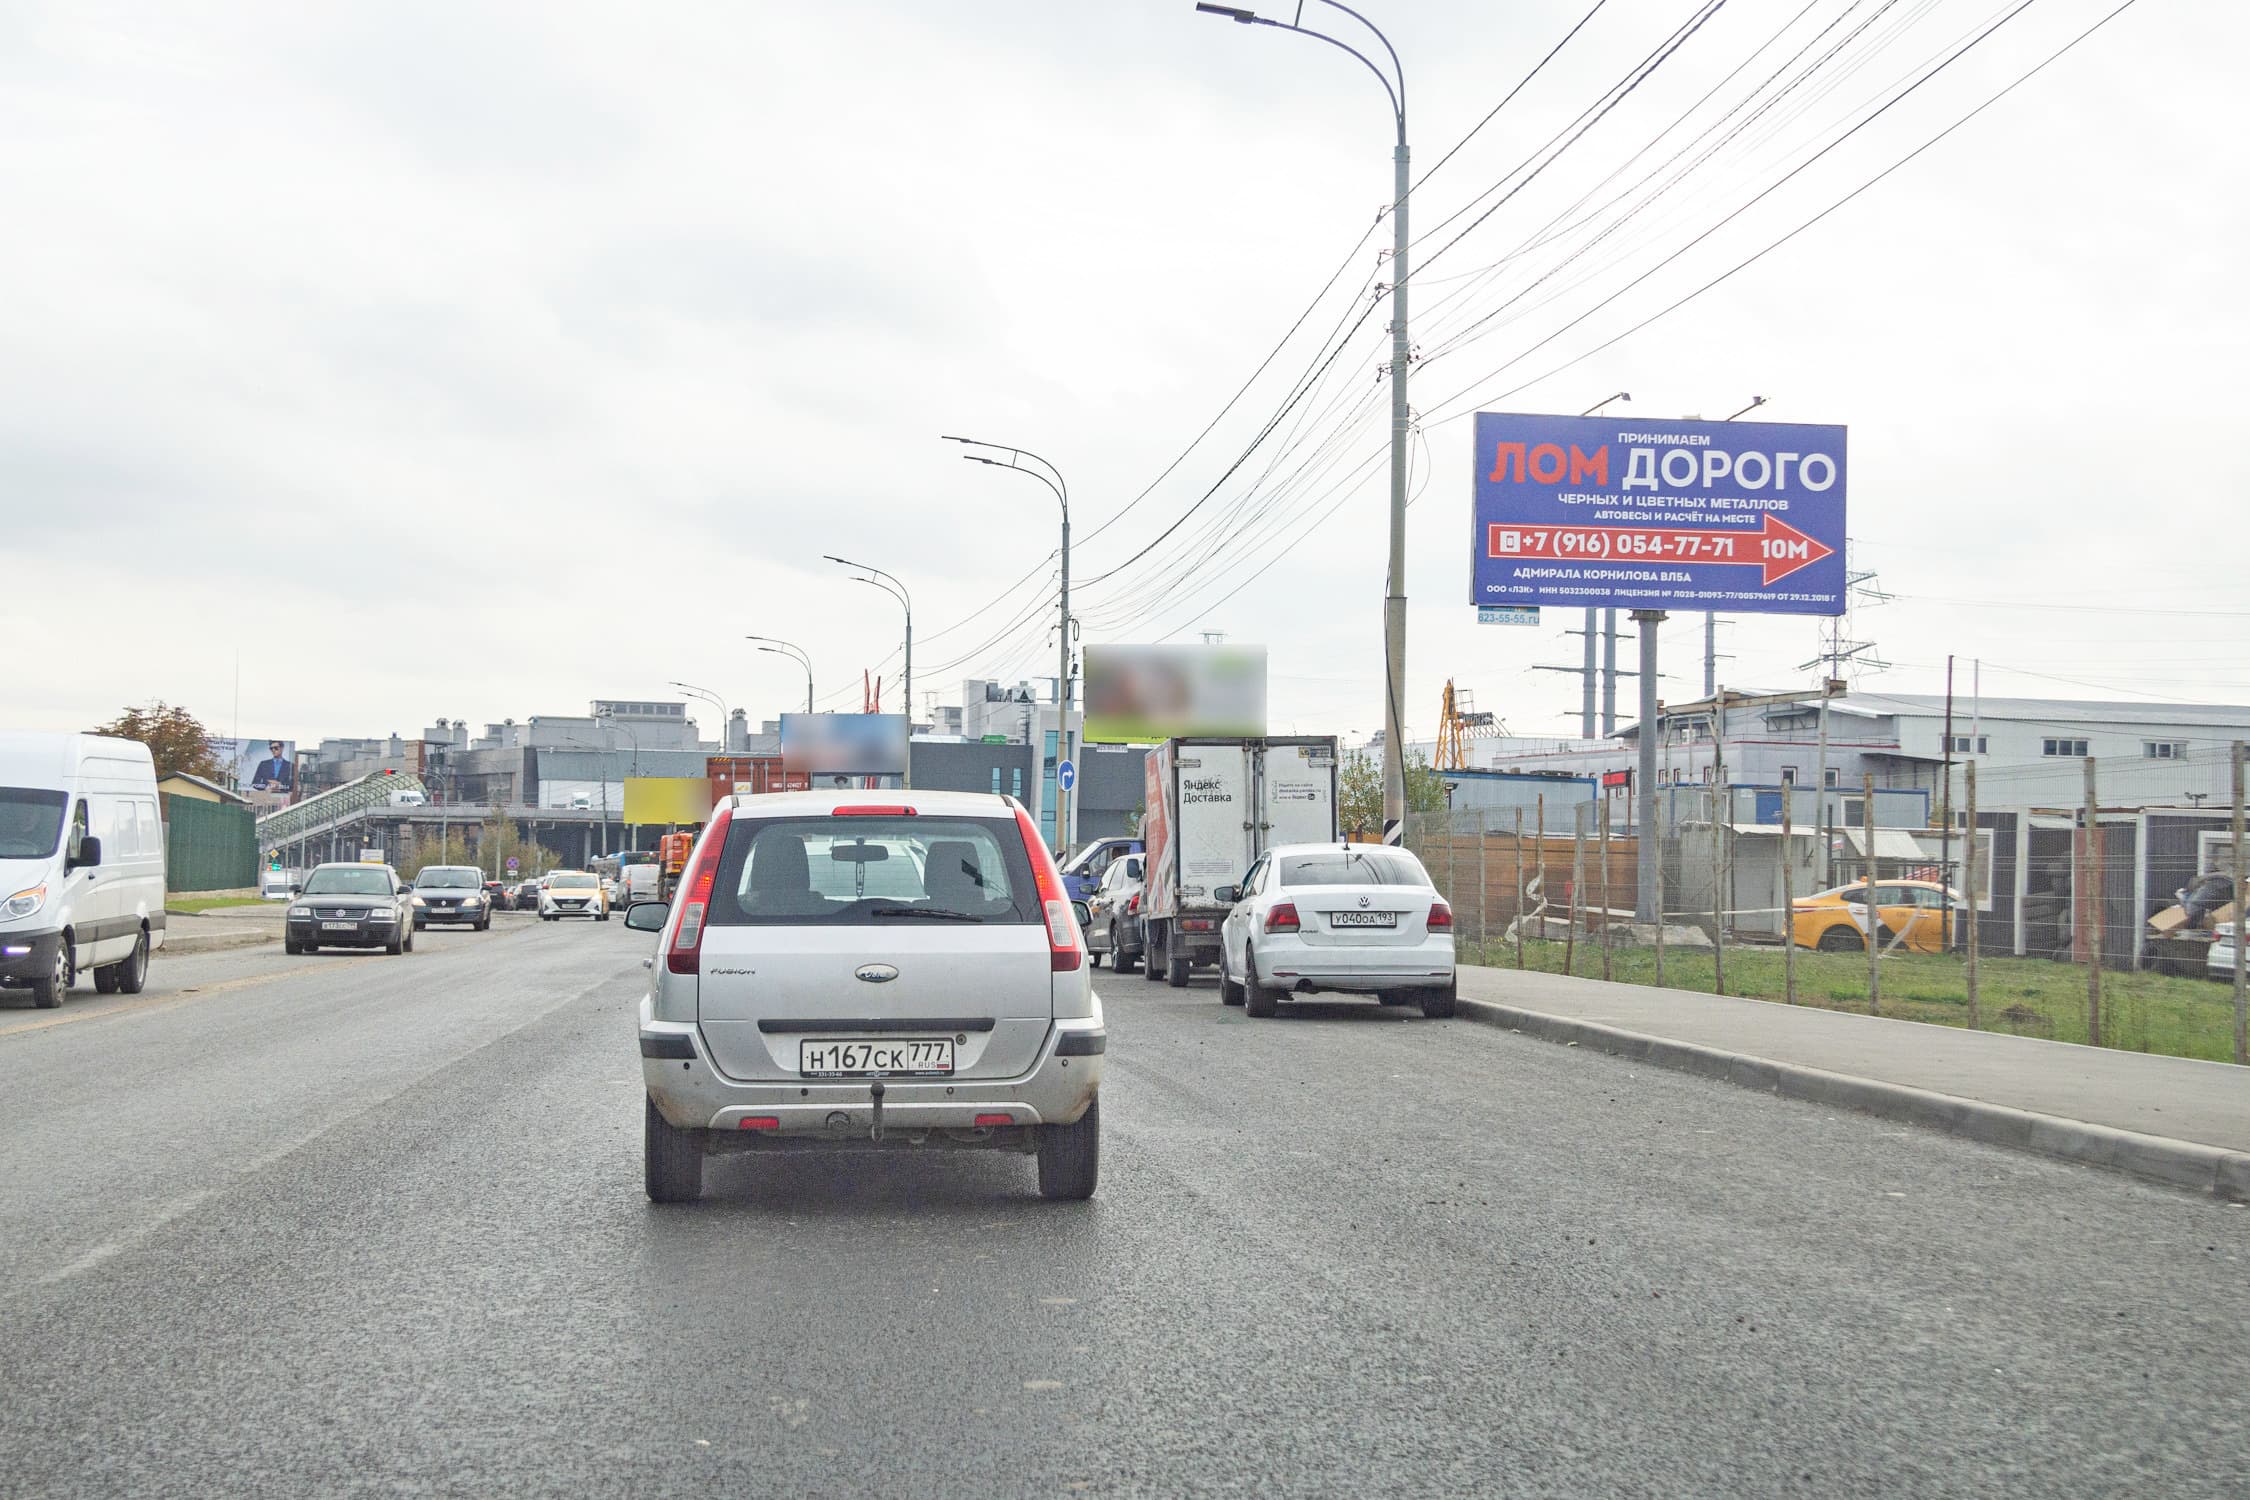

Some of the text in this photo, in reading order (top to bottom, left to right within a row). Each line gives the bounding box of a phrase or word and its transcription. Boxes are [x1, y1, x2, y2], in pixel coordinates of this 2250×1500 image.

[1618, 432, 1710, 446] ПРИНИМАЕМ
[1489, 442, 1836, 491] ЛОМ ДОРОГО
[1558, 493, 1789, 510] ЧЕРНЫХ И ЦВЕТНЫХ МЕТАЛЛОВ
[1594, 510, 1756, 523] АВТОВЕСЫ И РАСЧЁТ НА МЕСТЕ
[1523, 530, 1734, 558] +7 (916) 054-77-71
[1761, 539, 1809, 559] 10М
[1513, 568, 1580, 579] АДМИРАЛА
[1583, 569, 1658, 581] КОРНИЛОВА
[1486, 584, 1507, 593] ООО
[1539, 586, 1558, 594] ИНН
[1614, 588, 1660, 598] ЛИЦЕНЗИЯ
[1777, 592, 1789, 601] ОТ
[1183, 779, 1220, 791] Яндекс
[1183, 793, 1232, 804] Доставка
[710, 967, 756, 975] FUSION
[909, 1043, 945, 1062] 777
